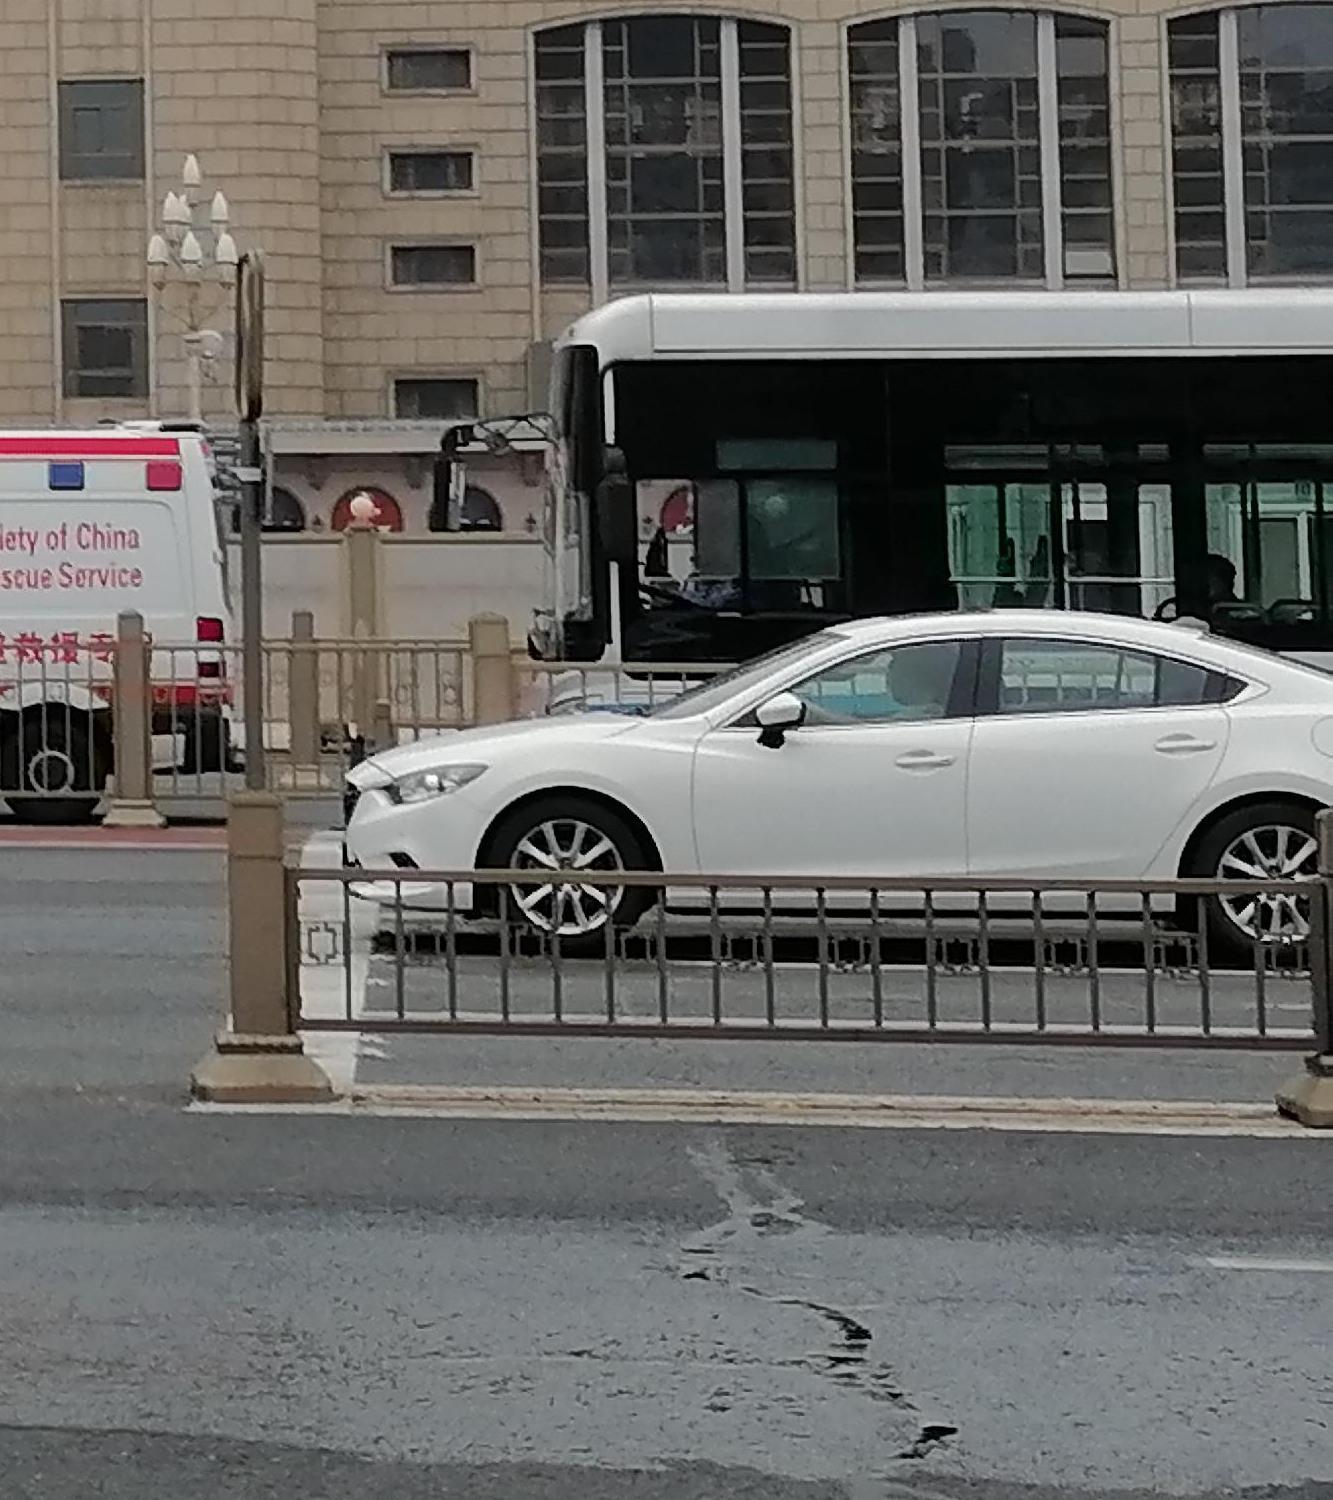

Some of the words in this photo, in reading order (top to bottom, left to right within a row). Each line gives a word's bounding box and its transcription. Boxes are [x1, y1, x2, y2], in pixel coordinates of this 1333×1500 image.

[45, 522, 67, 551] of
[76, 522, 140, 550] China
[58, 561, 143, 589] Service
